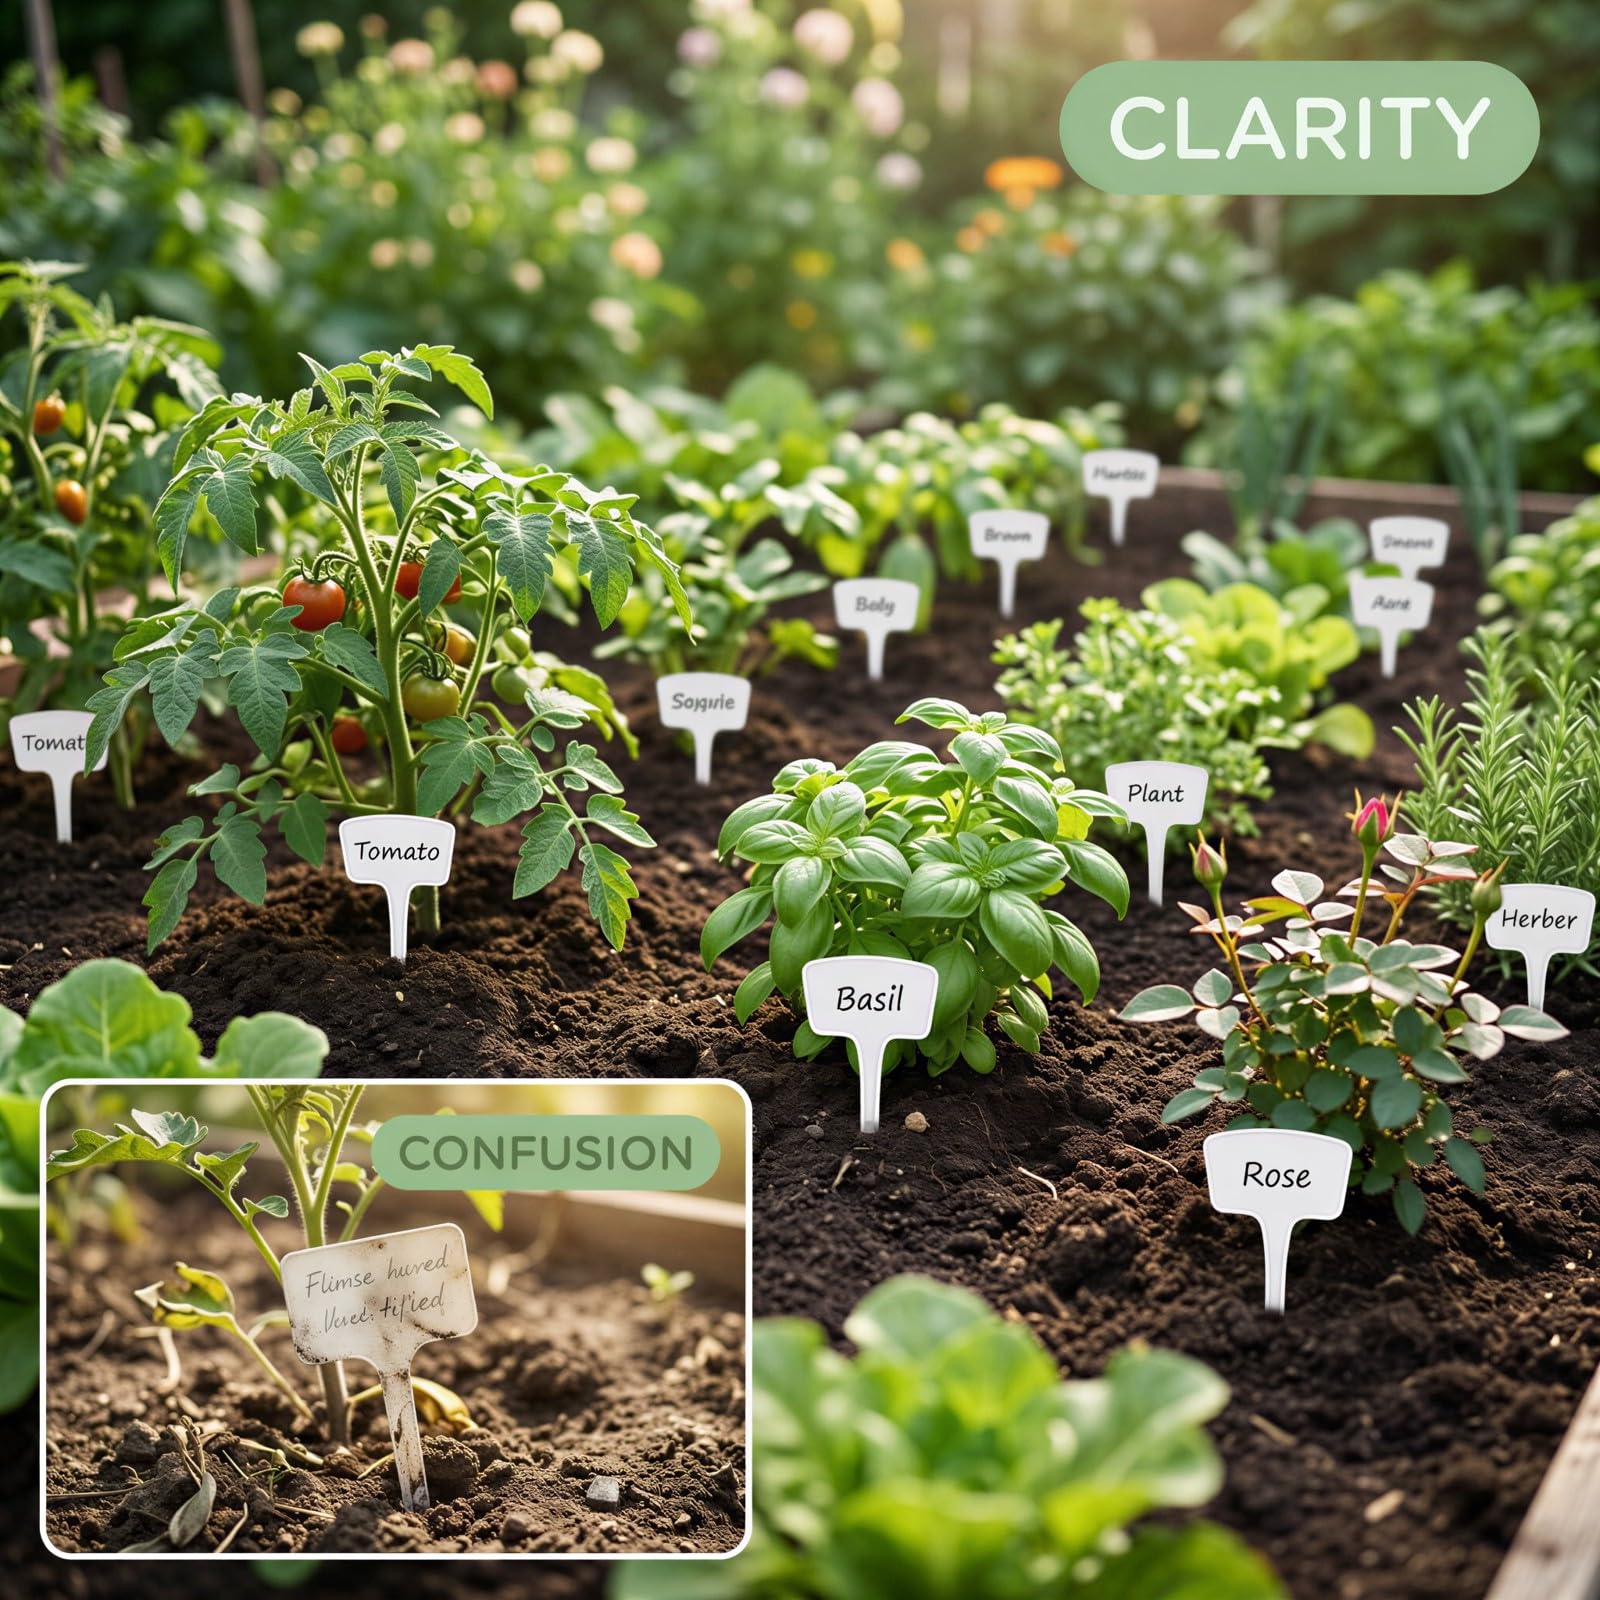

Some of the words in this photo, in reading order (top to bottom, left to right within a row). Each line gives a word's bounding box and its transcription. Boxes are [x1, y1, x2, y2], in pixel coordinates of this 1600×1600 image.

[22, 734, 85, 752] Tomat
[1128, 782, 1185, 803] Plant
[354, 840, 440, 862] Tomato
[1502, 907, 1578, 930] Herber
[836, 983, 904, 1012] Basil
[1242, 1162, 1312, 1189] Rose
